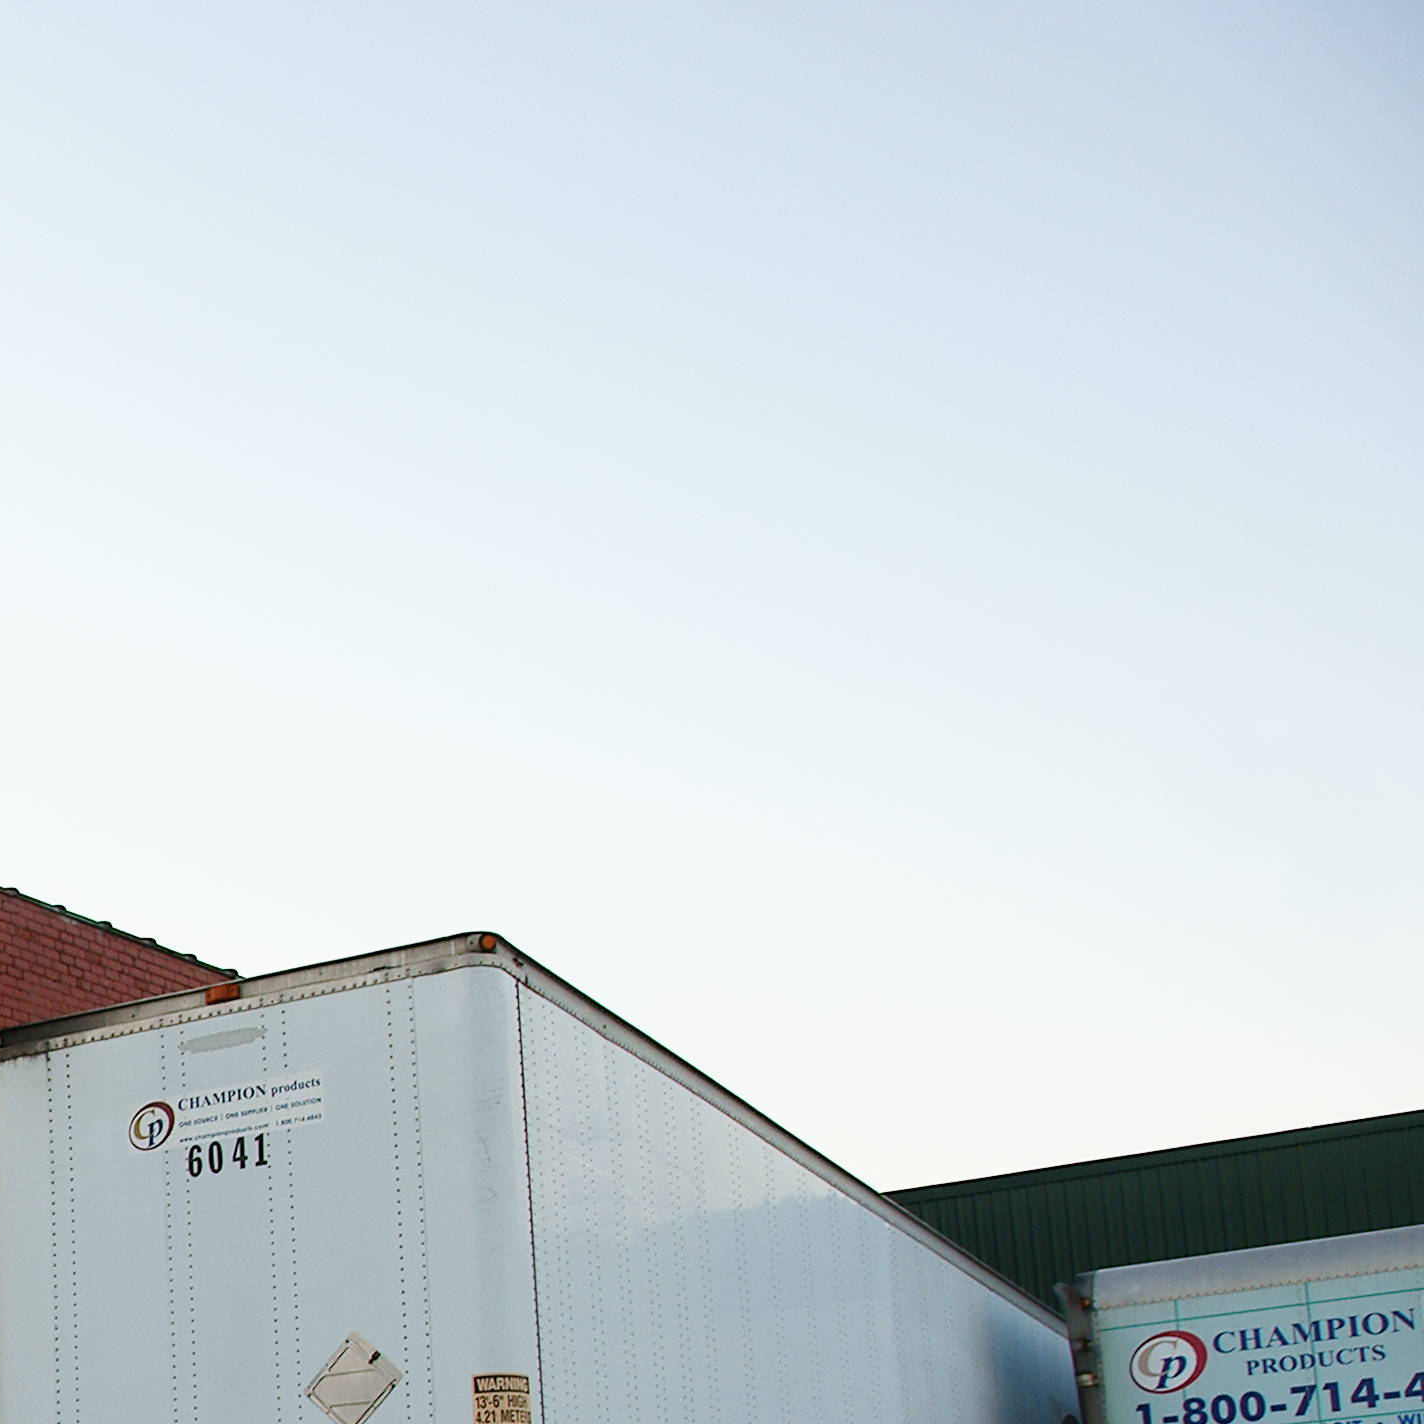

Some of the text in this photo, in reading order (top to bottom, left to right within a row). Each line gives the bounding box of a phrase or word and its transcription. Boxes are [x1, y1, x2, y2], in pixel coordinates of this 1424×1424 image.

[178, 1078, 321, 1111] CHAMPION products
[225, 1109, 239, 1119] ONE
[275, 1102, 289, 1111] ONE
[291, 1097, 322, 1108] SOLUTION
[187, 1132, 268, 1178] 6041
[1212, 1308, 1416, 1354] CHAMPION
[1246, 1344, 1387, 1376] PRODUCTS
[476, 1376, 529, 1392] WARNING
[475, 1410, 496, 1423] 4.21
